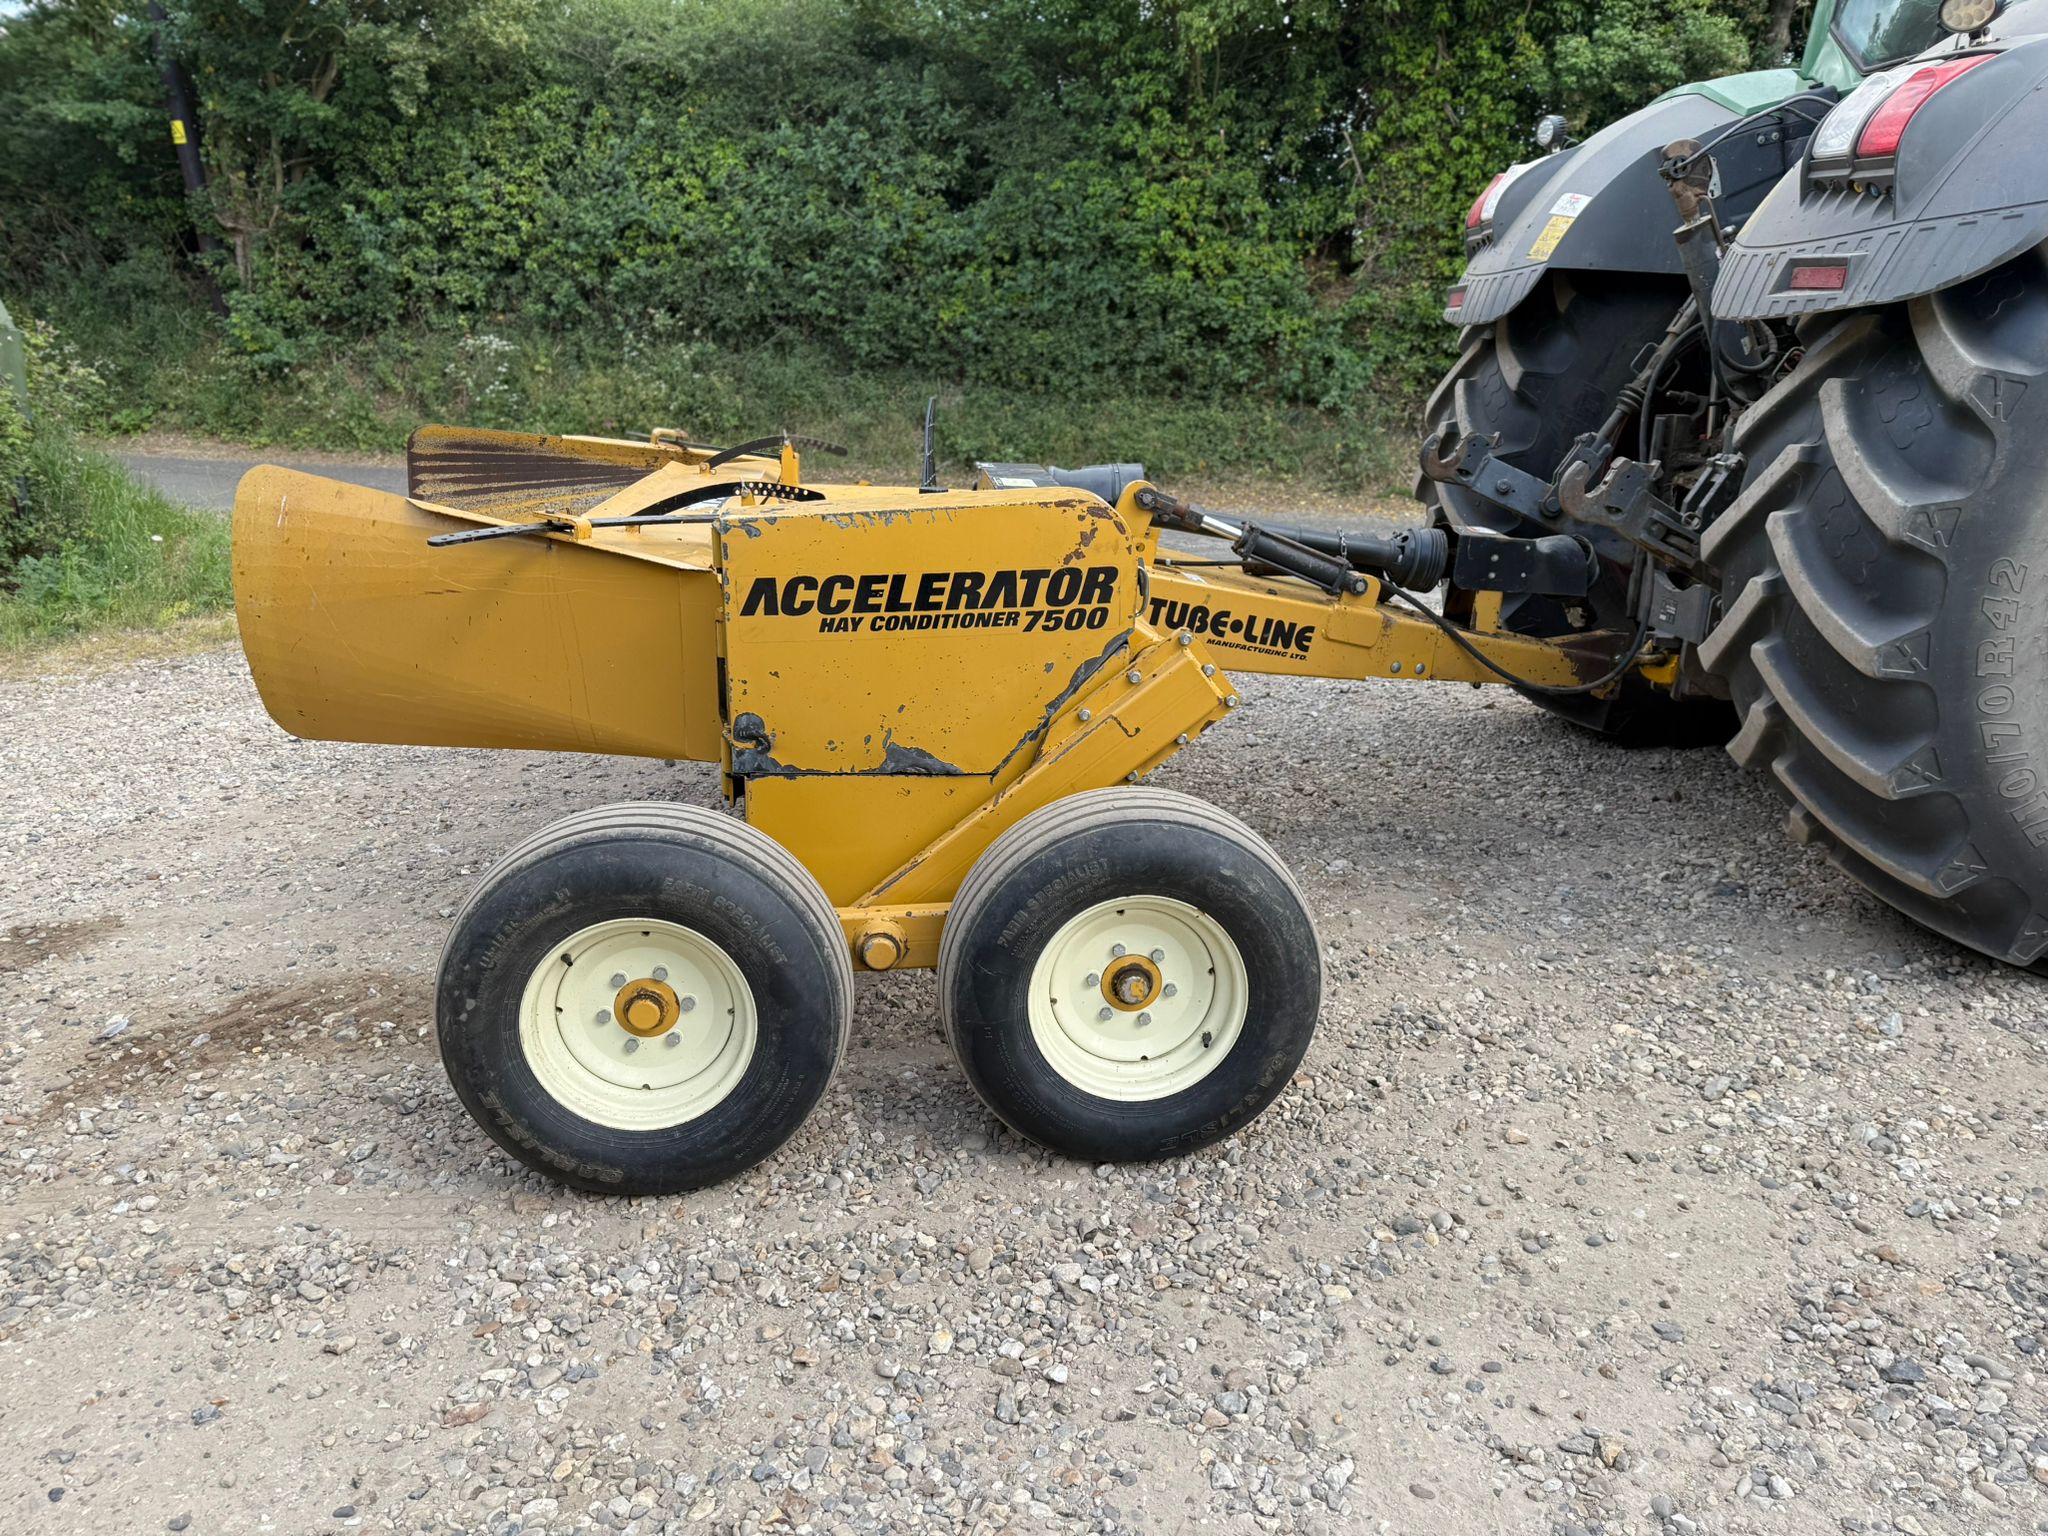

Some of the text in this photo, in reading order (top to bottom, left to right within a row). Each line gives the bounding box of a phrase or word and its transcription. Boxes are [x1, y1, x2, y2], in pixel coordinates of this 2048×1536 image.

[740, 566, 1119, 616] ACCELERATOR
[819, 607, 1109, 633] HAY CONDITIONER 7500
[1206, 638, 1308, 661] MANUFACTURING LTD.
